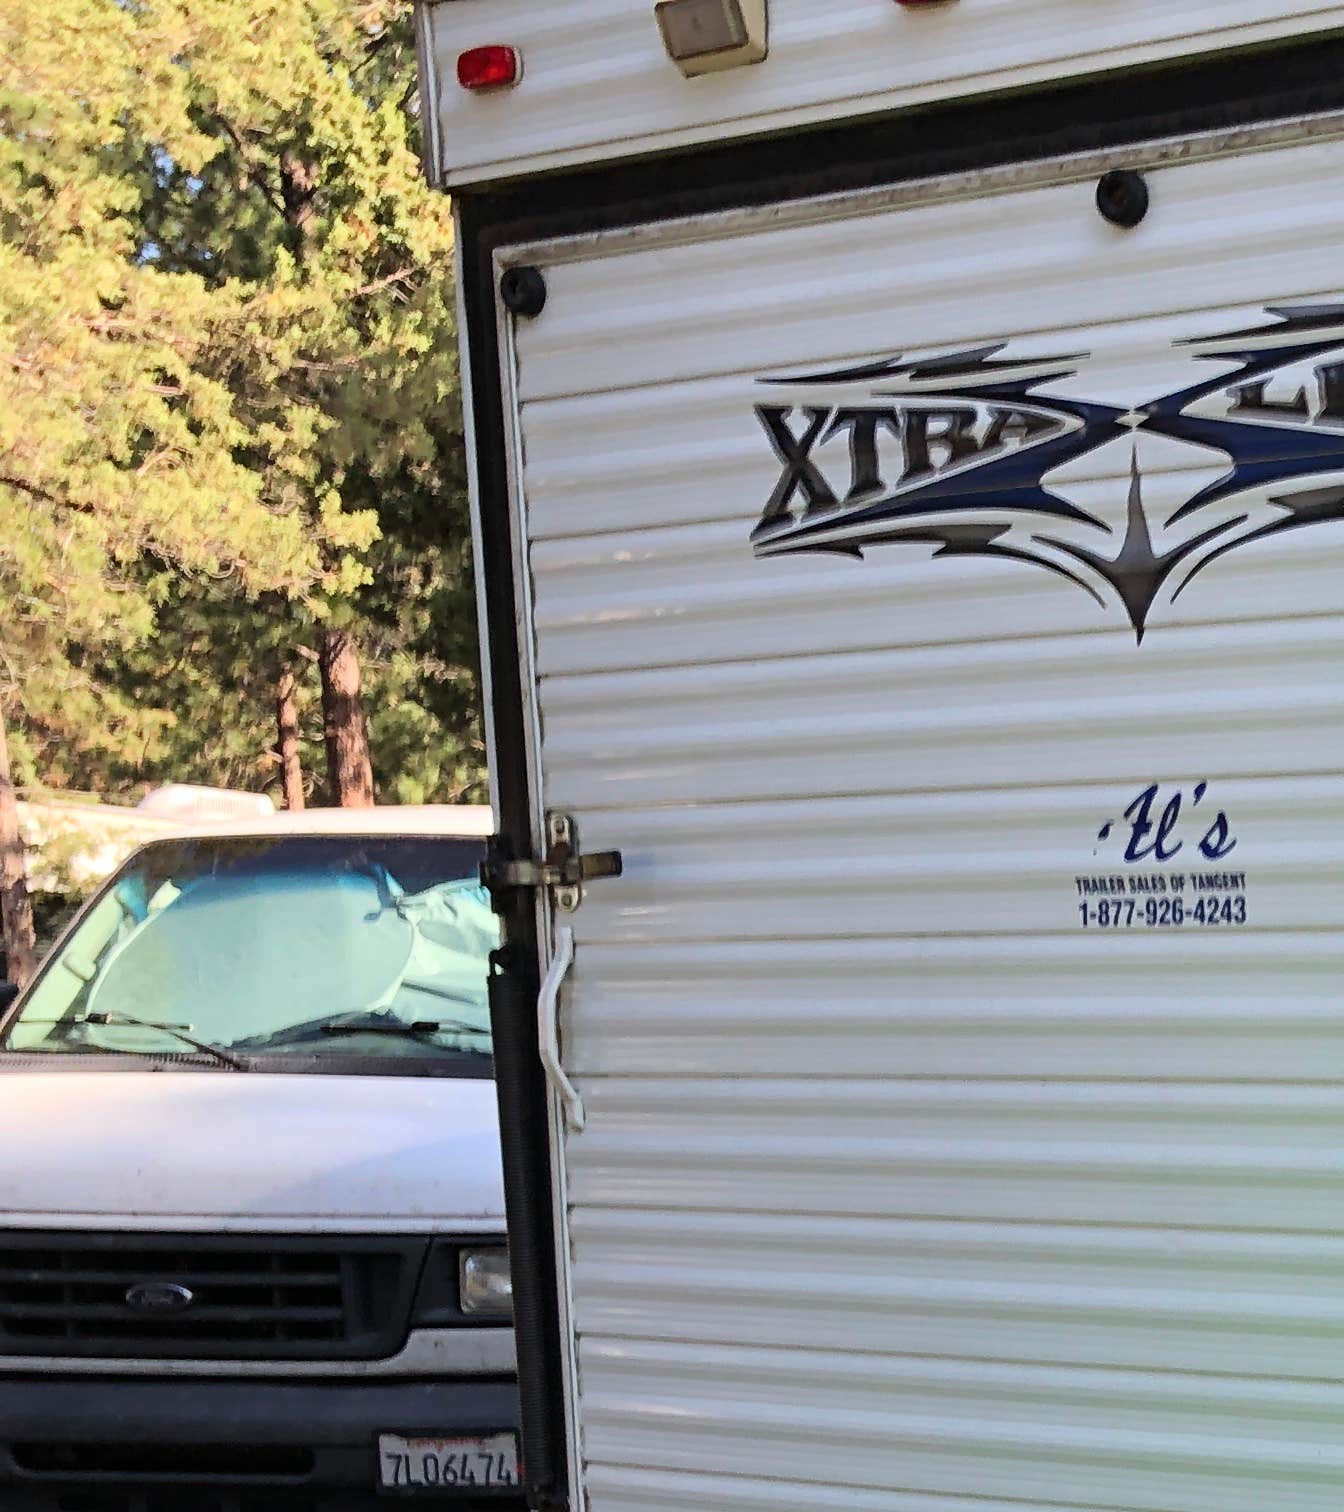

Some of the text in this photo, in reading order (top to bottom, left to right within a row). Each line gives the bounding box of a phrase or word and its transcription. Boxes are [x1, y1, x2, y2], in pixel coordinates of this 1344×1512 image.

[1075, 872, 1247, 896] TRAILER SALES OF TANGENT
[1078, 895, 1247, 928] 1-877-926-4243
